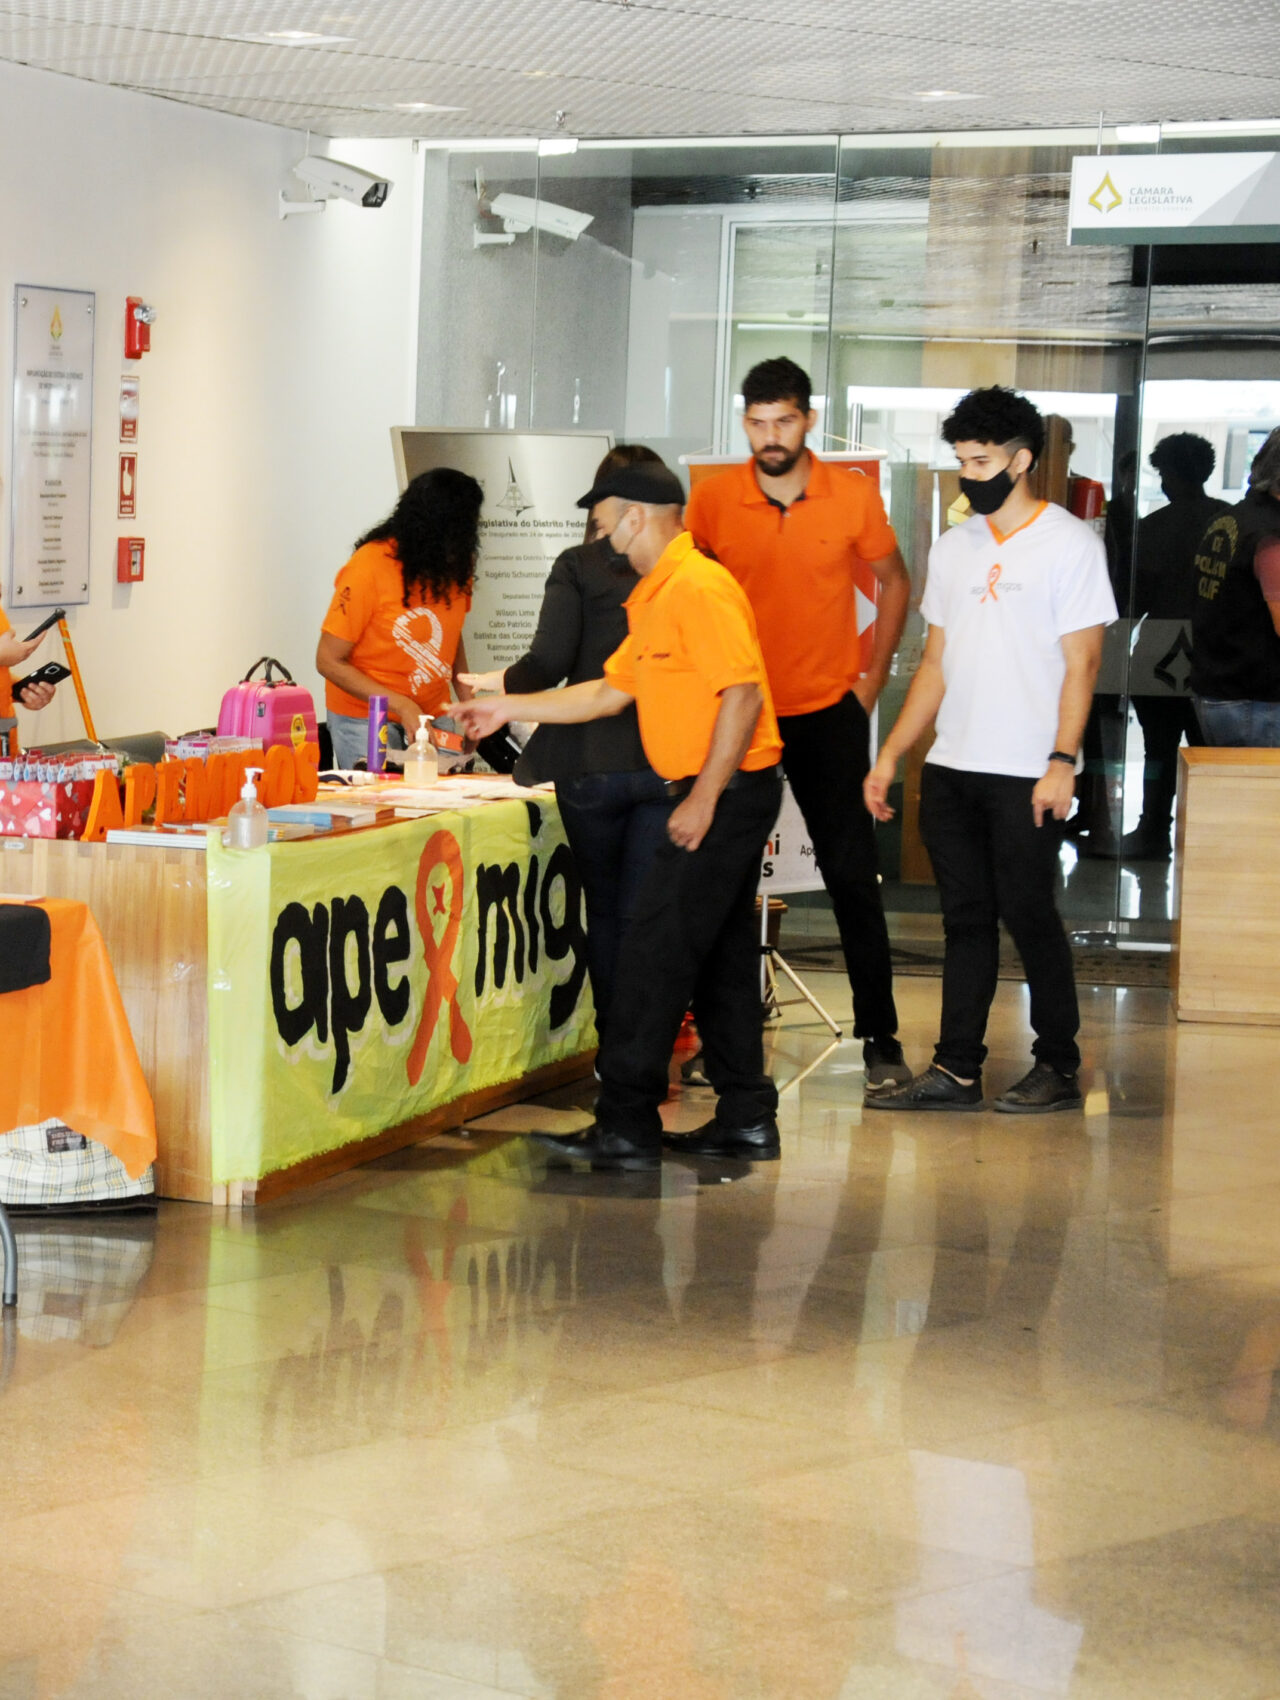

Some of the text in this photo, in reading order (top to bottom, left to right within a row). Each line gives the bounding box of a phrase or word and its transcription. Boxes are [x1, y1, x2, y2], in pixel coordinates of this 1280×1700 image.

[1128, 196, 1193, 205] LEGISLATIVA
[479, 519, 518, 528] egislativa
[520, 519, 531, 528] do
[533, 519, 563, 528] Distrito
[270, 801, 588, 1095] ape mig
